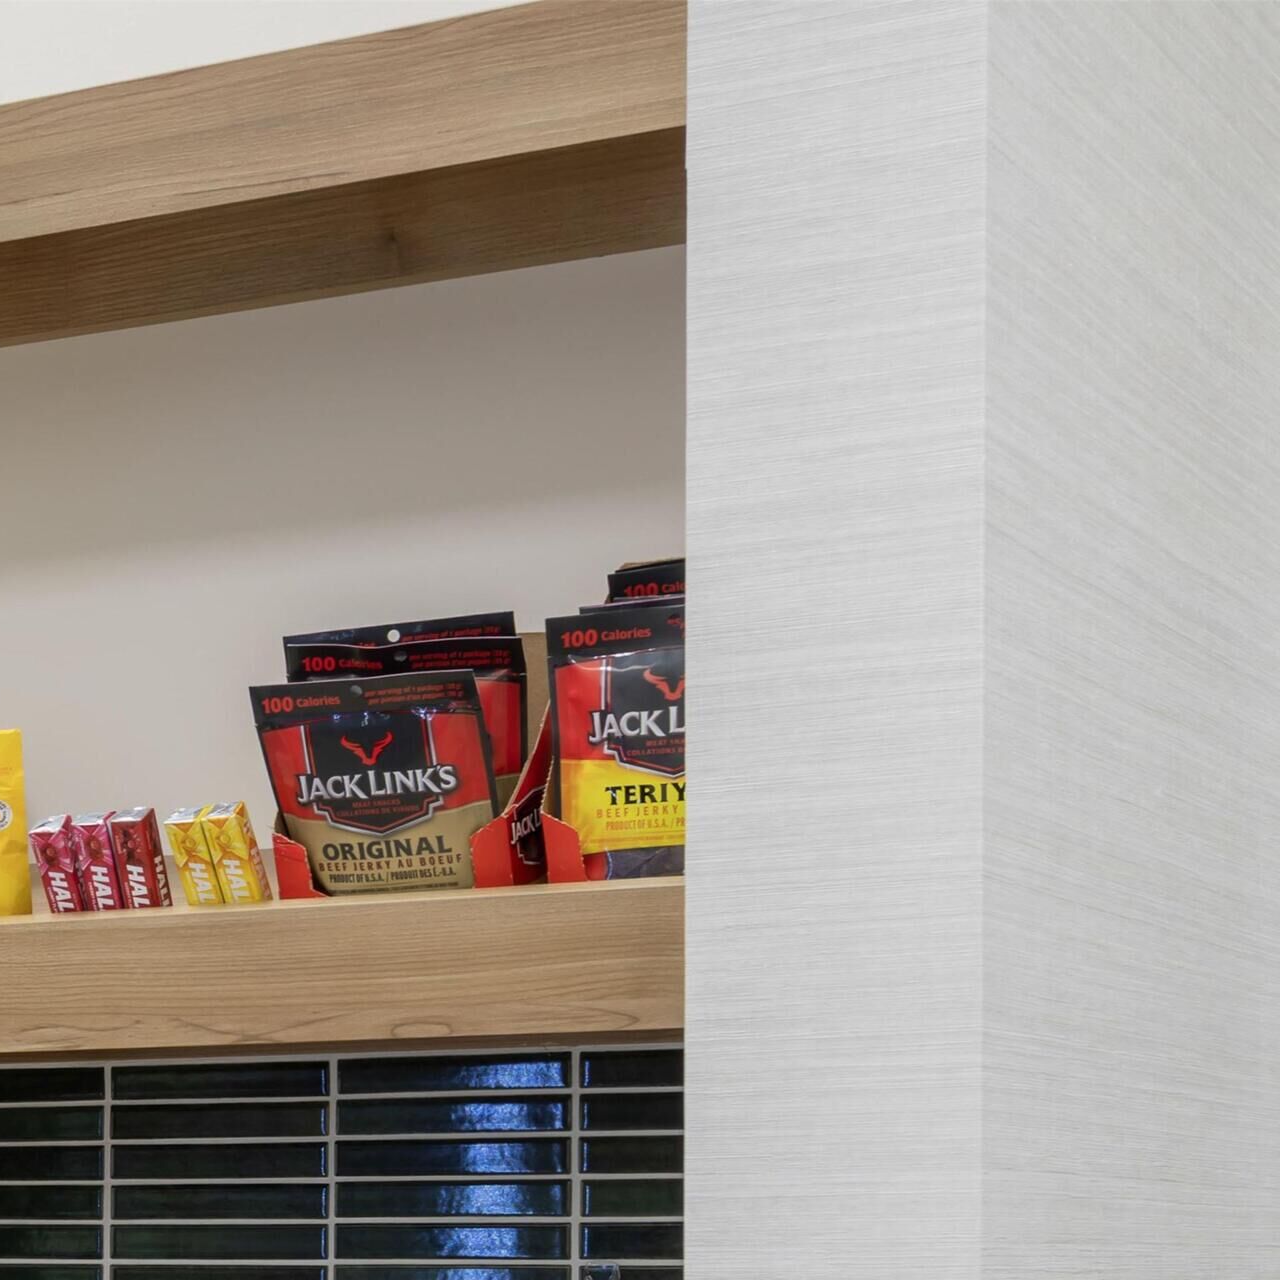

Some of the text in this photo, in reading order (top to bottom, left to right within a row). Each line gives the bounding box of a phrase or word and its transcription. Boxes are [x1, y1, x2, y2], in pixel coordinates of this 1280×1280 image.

[561, 629, 598, 649] 100
[302, 657, 336, 672] 100
[262, 697, 294, 714] 100
[589, 709, 665, 743] JACK
[298, 765, 458, 803] JACK LINK'S
[596, 805, 678, 818] BEEF JERKY
[322, 835, 453, 861] ORIGINAL
[319, 853, 463, 872] BEEF JERKY AU BOEUF
